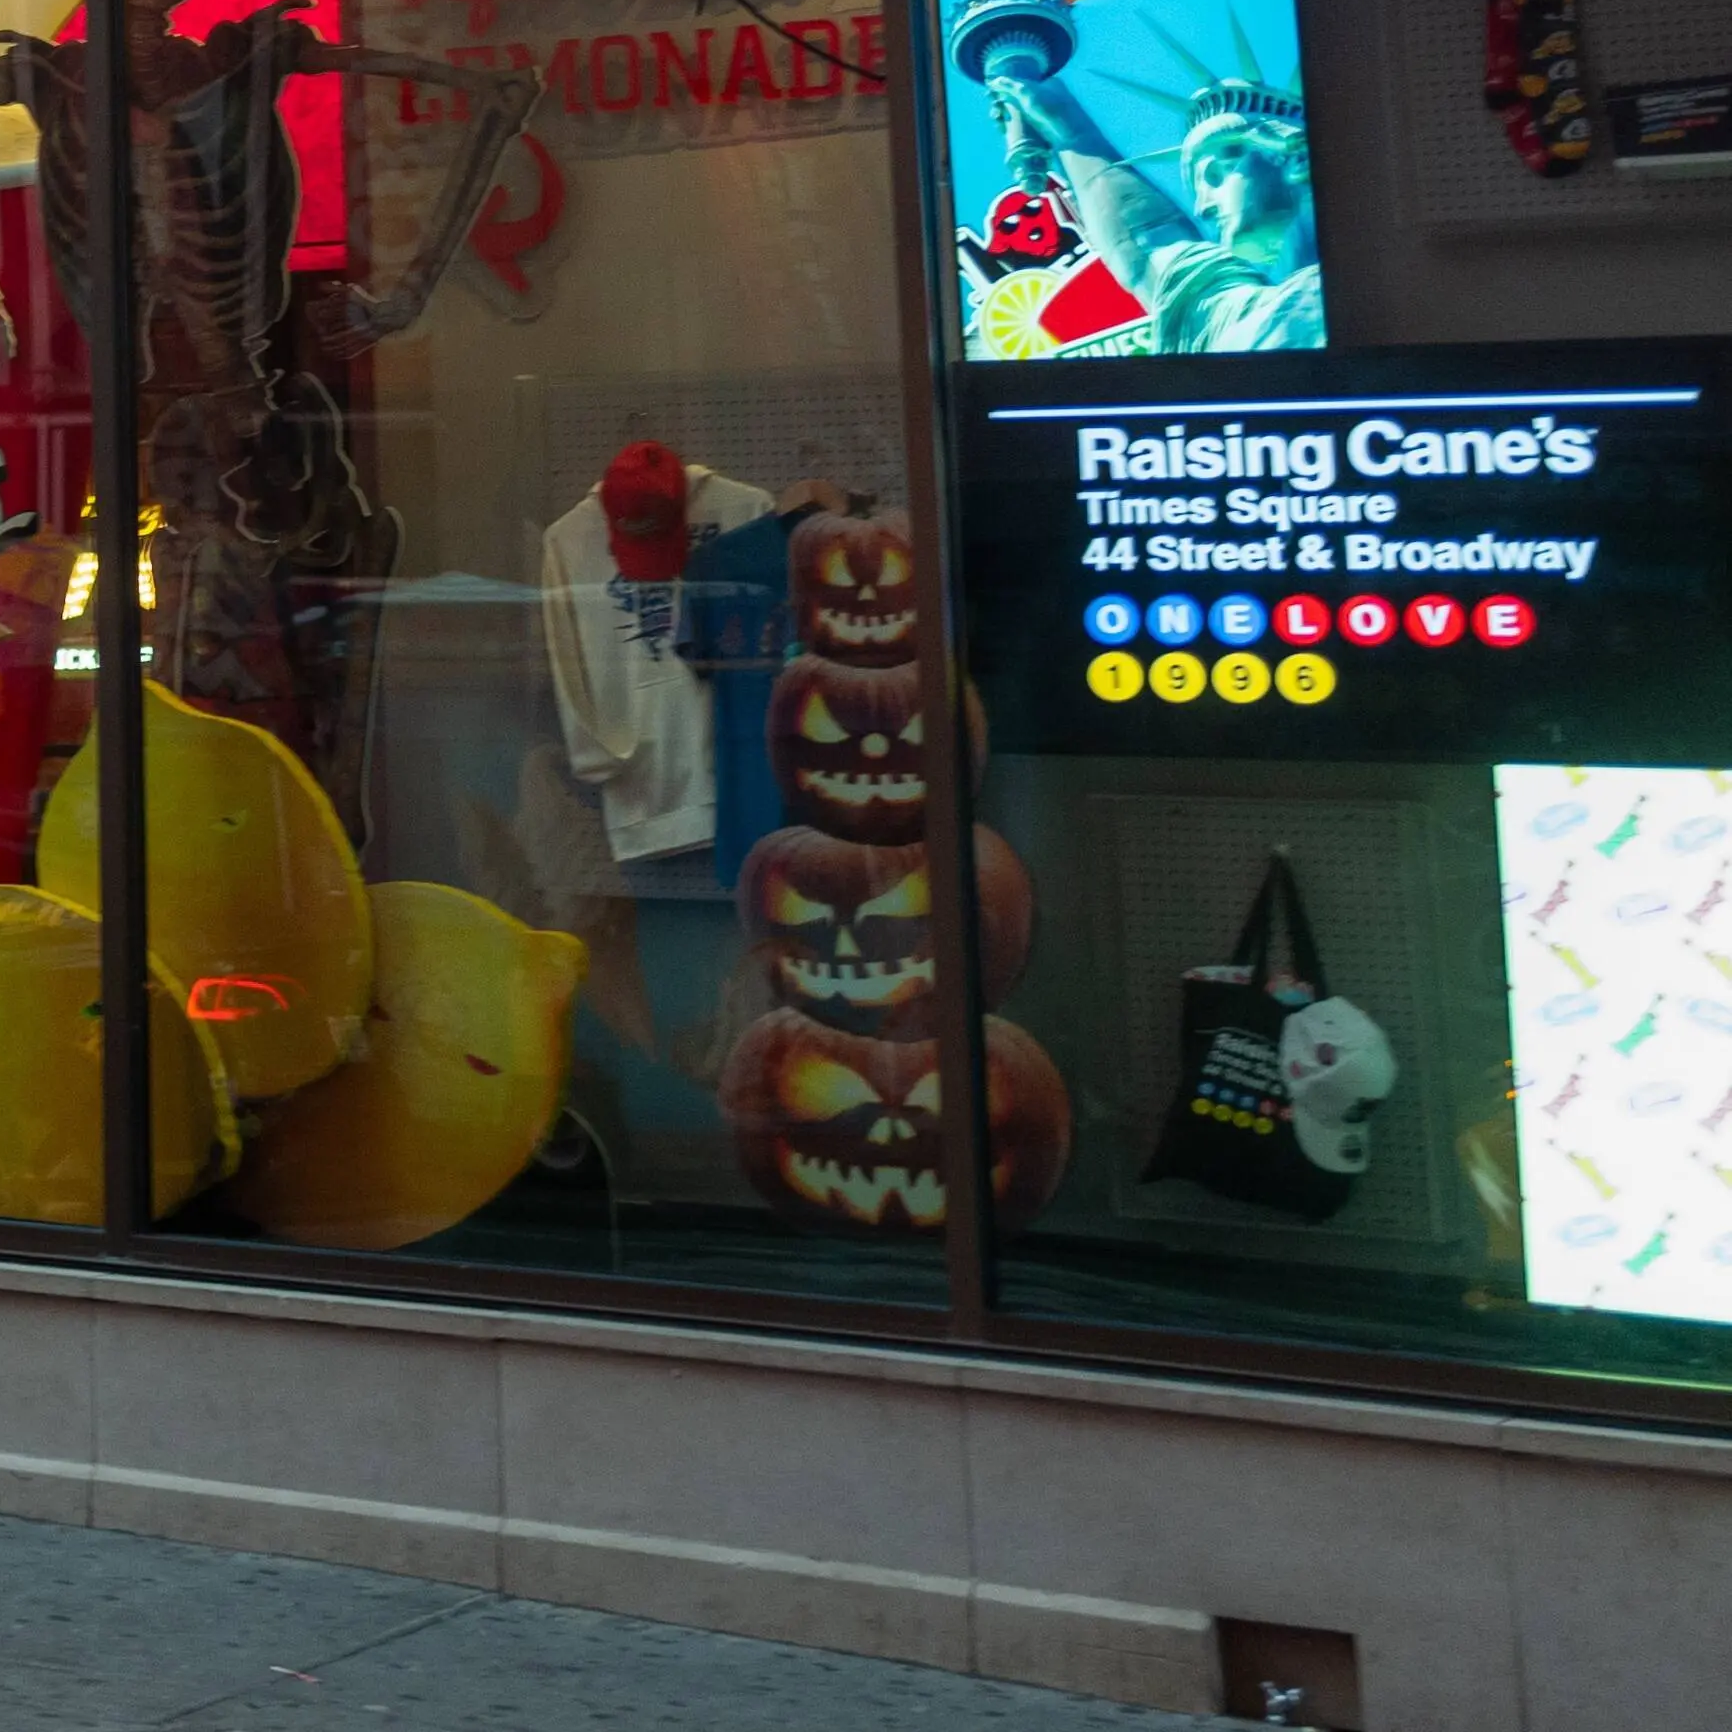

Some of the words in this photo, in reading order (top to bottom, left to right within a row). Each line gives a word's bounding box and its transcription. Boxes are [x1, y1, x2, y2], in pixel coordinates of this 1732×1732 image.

[1077, 424, 1336, 490] Raising
[1348, 417, 1594, 480] Cane's
[1078, 490, 1218, 526] Times
[1226, 490, 1397, 531] Square
[1082, 538, 1138, 571] 44
[1146, 536, 1286, 573] Street
[1294, 538, 1336, 570] &
[1344, 533, 1596, 580] Broadway
